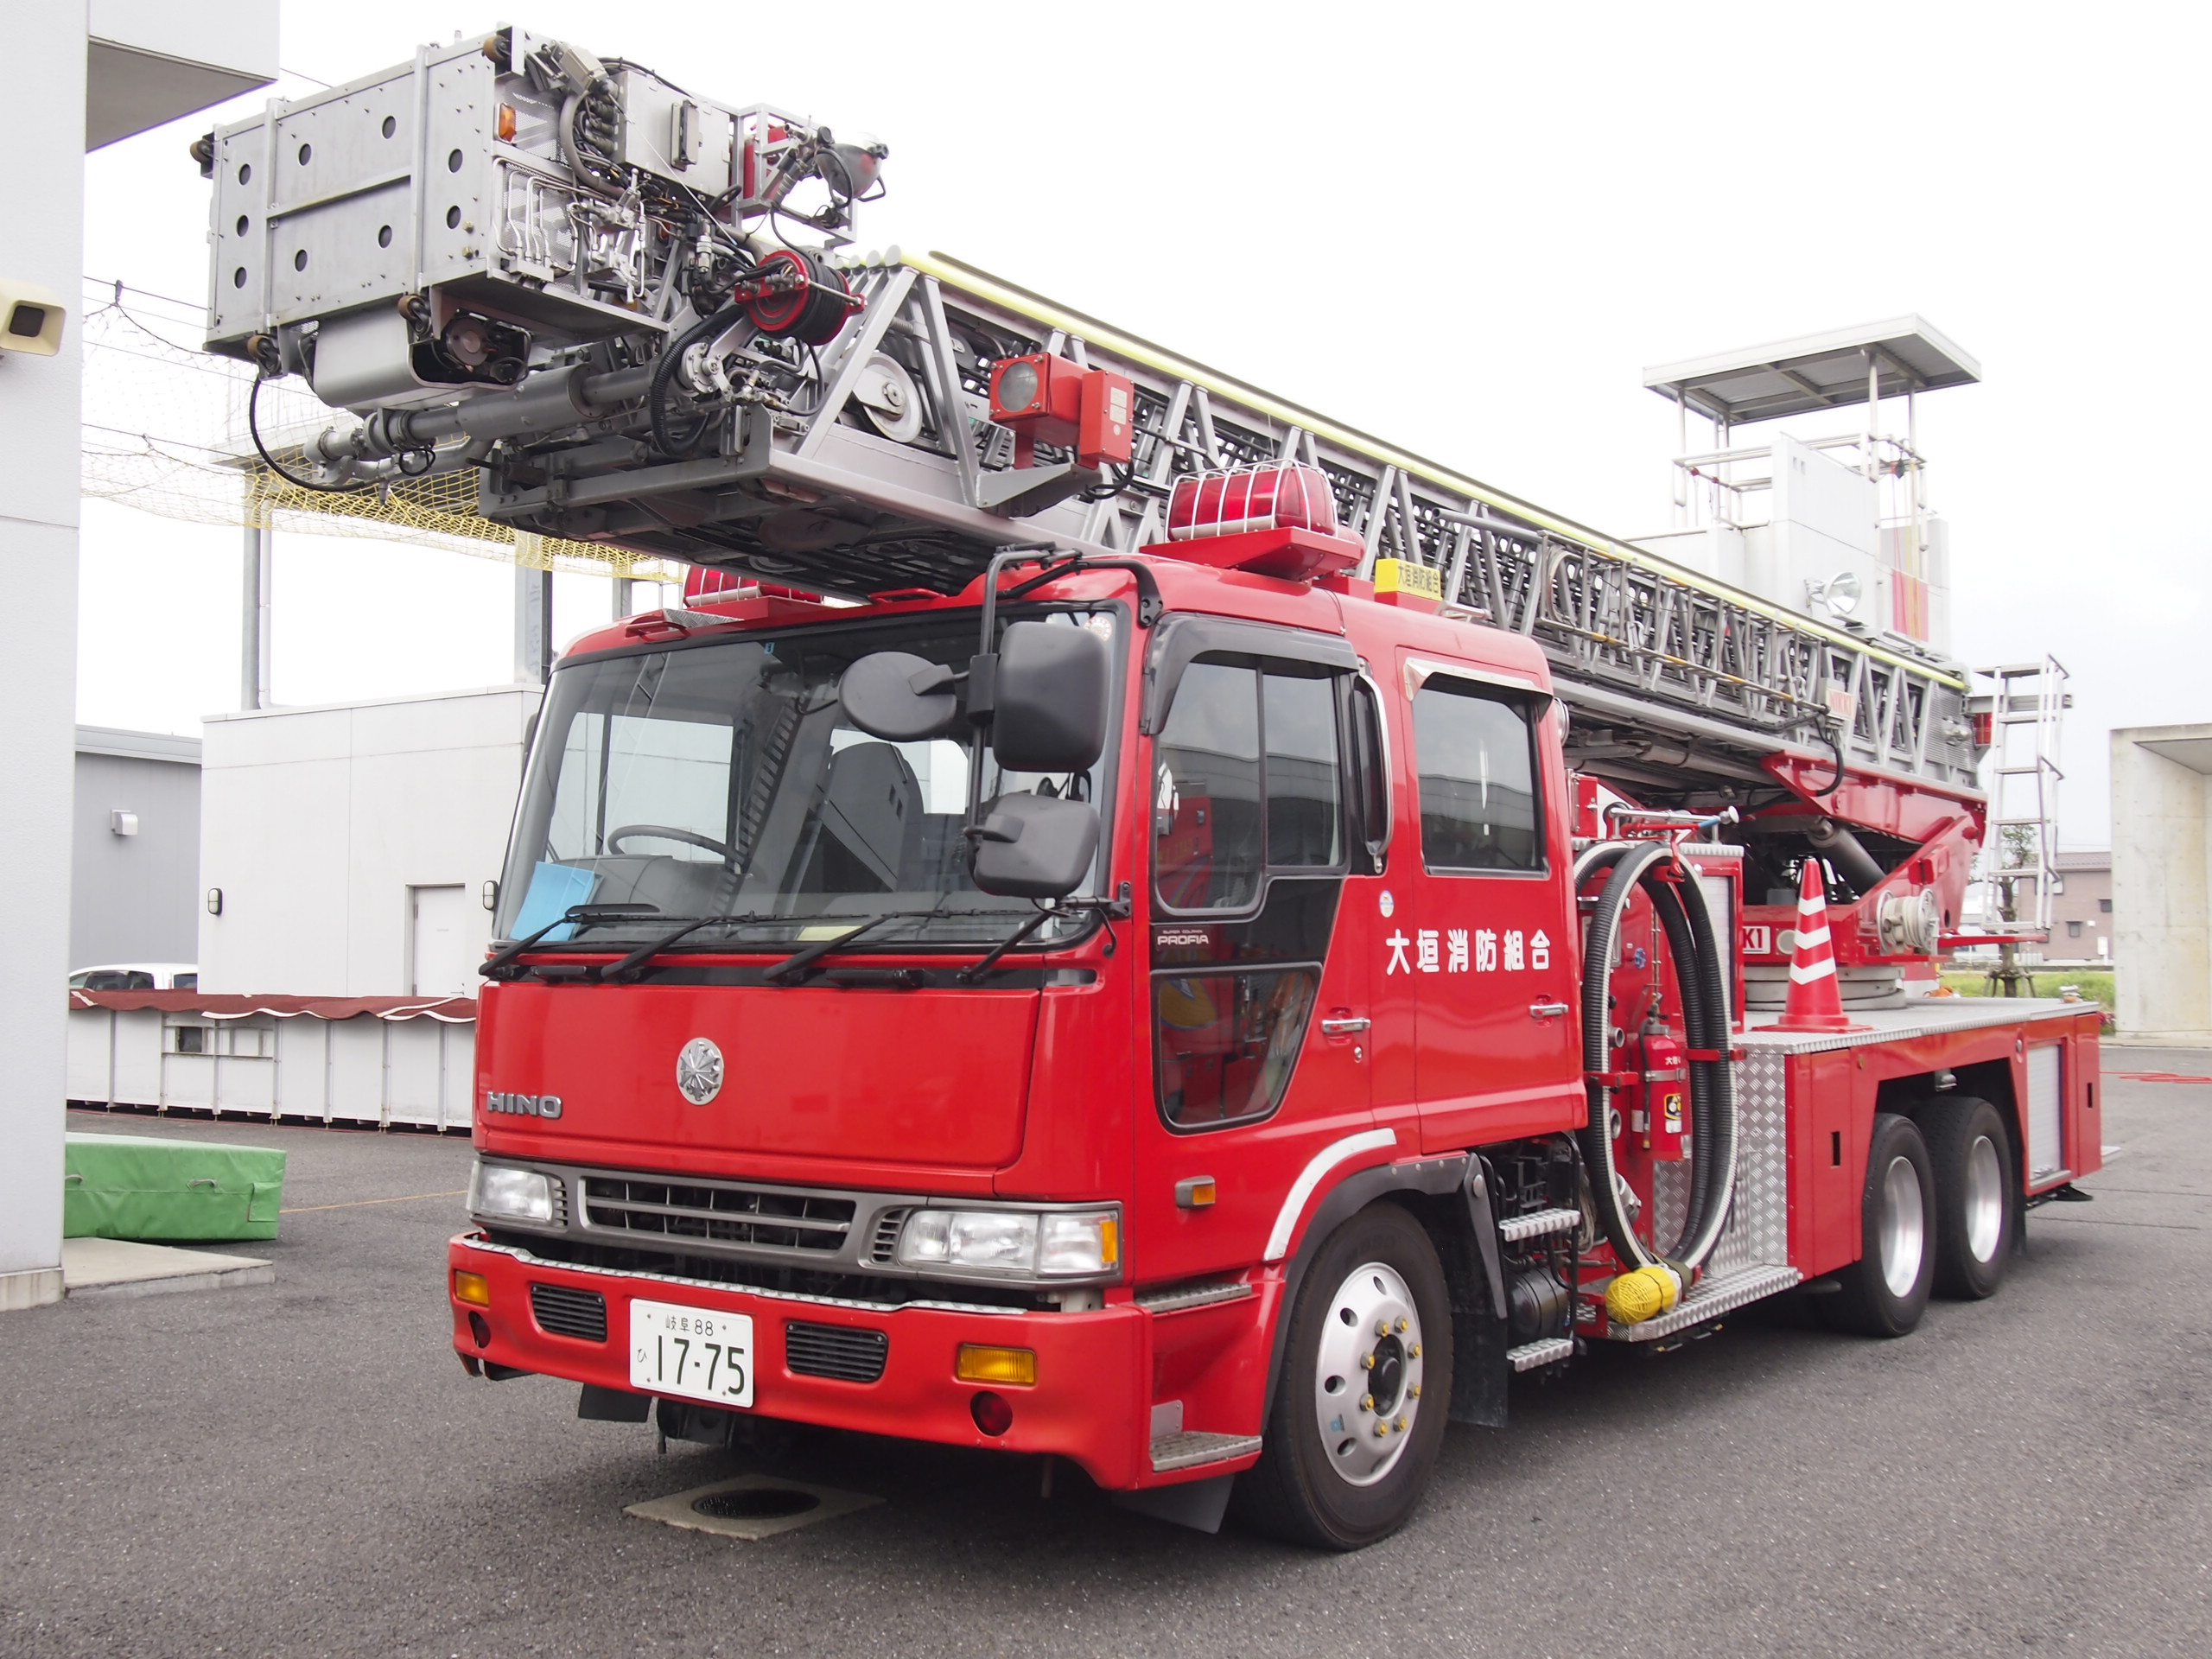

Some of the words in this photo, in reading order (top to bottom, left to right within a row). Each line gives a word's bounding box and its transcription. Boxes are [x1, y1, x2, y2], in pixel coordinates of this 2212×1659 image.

[1157, 935, 1209, 946] PROFIA
[1385, 928, 1550, 976] 大垣消防組合
[486, 1091, 563, 1120] HINO
[658, 1335, 745, 1395] 17-75
